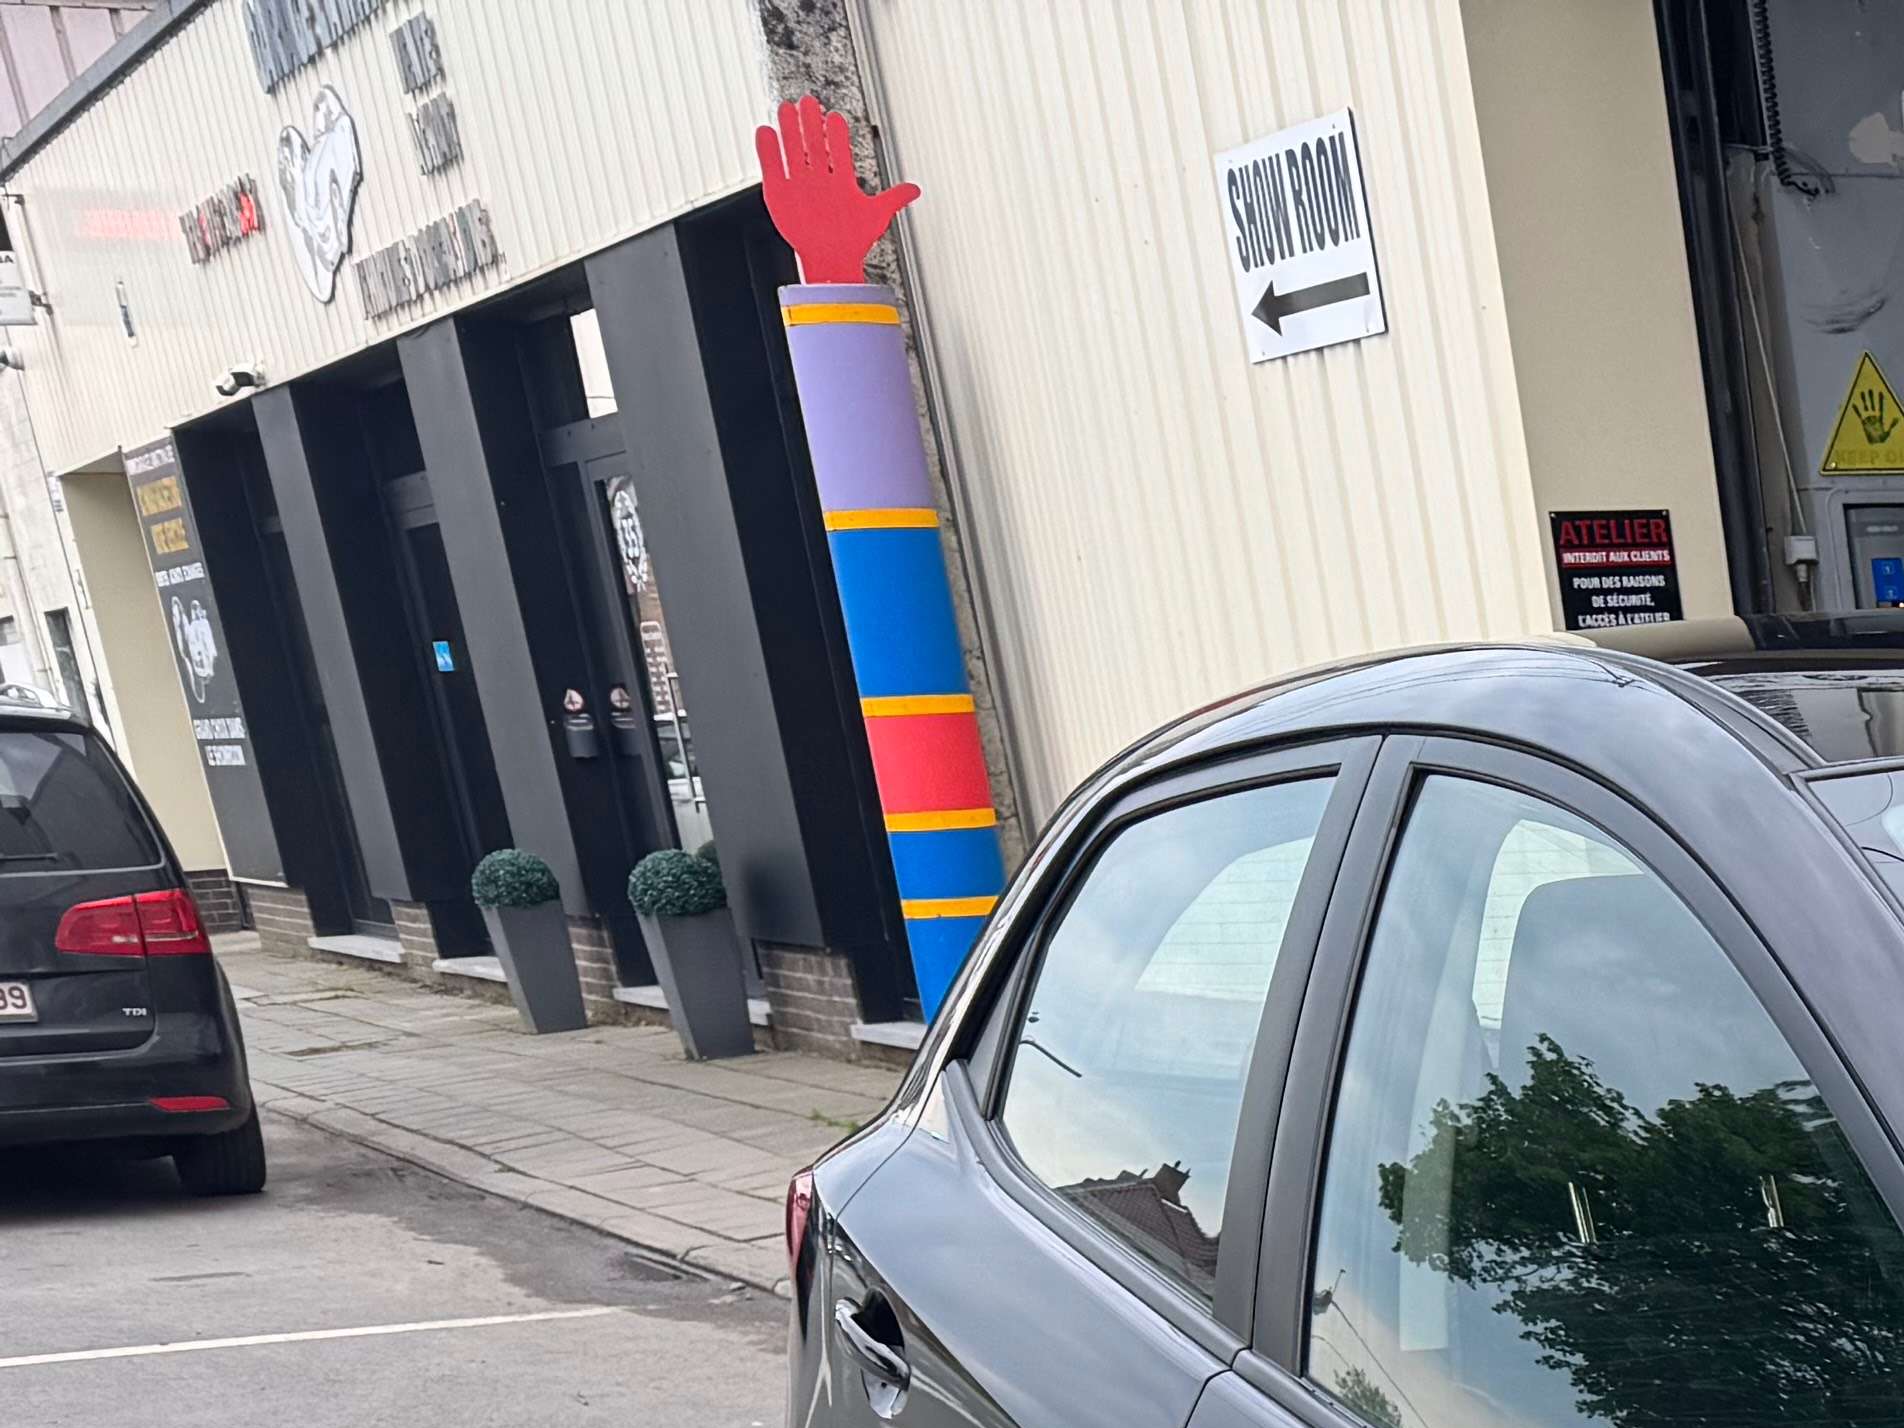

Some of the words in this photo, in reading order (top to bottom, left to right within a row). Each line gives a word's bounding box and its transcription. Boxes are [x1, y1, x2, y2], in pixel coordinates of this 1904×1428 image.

[1227, 152, 1295, 273] SHOW
[1284, 130, 1361, 255] ROOM
[1836, 449, 1880, 465] KEEP
[1560, 518, 1669, 545] ATELIER
[1562, 551, 1606, 564] INTERDIT
[1609, 551, 1630, 563] AUX
[1630, 550, 1671, 562] CLIENTS
[1572, 577, 1601, 589] POUR
[1601, 576, 1621, 588] DES
[1622, 575, 1666, 587] RAISONS
[1591, 595, 1606, 608] DE
[1618, 610, 1627, 626] À
[121, 1007, 147, 1017] TDI
